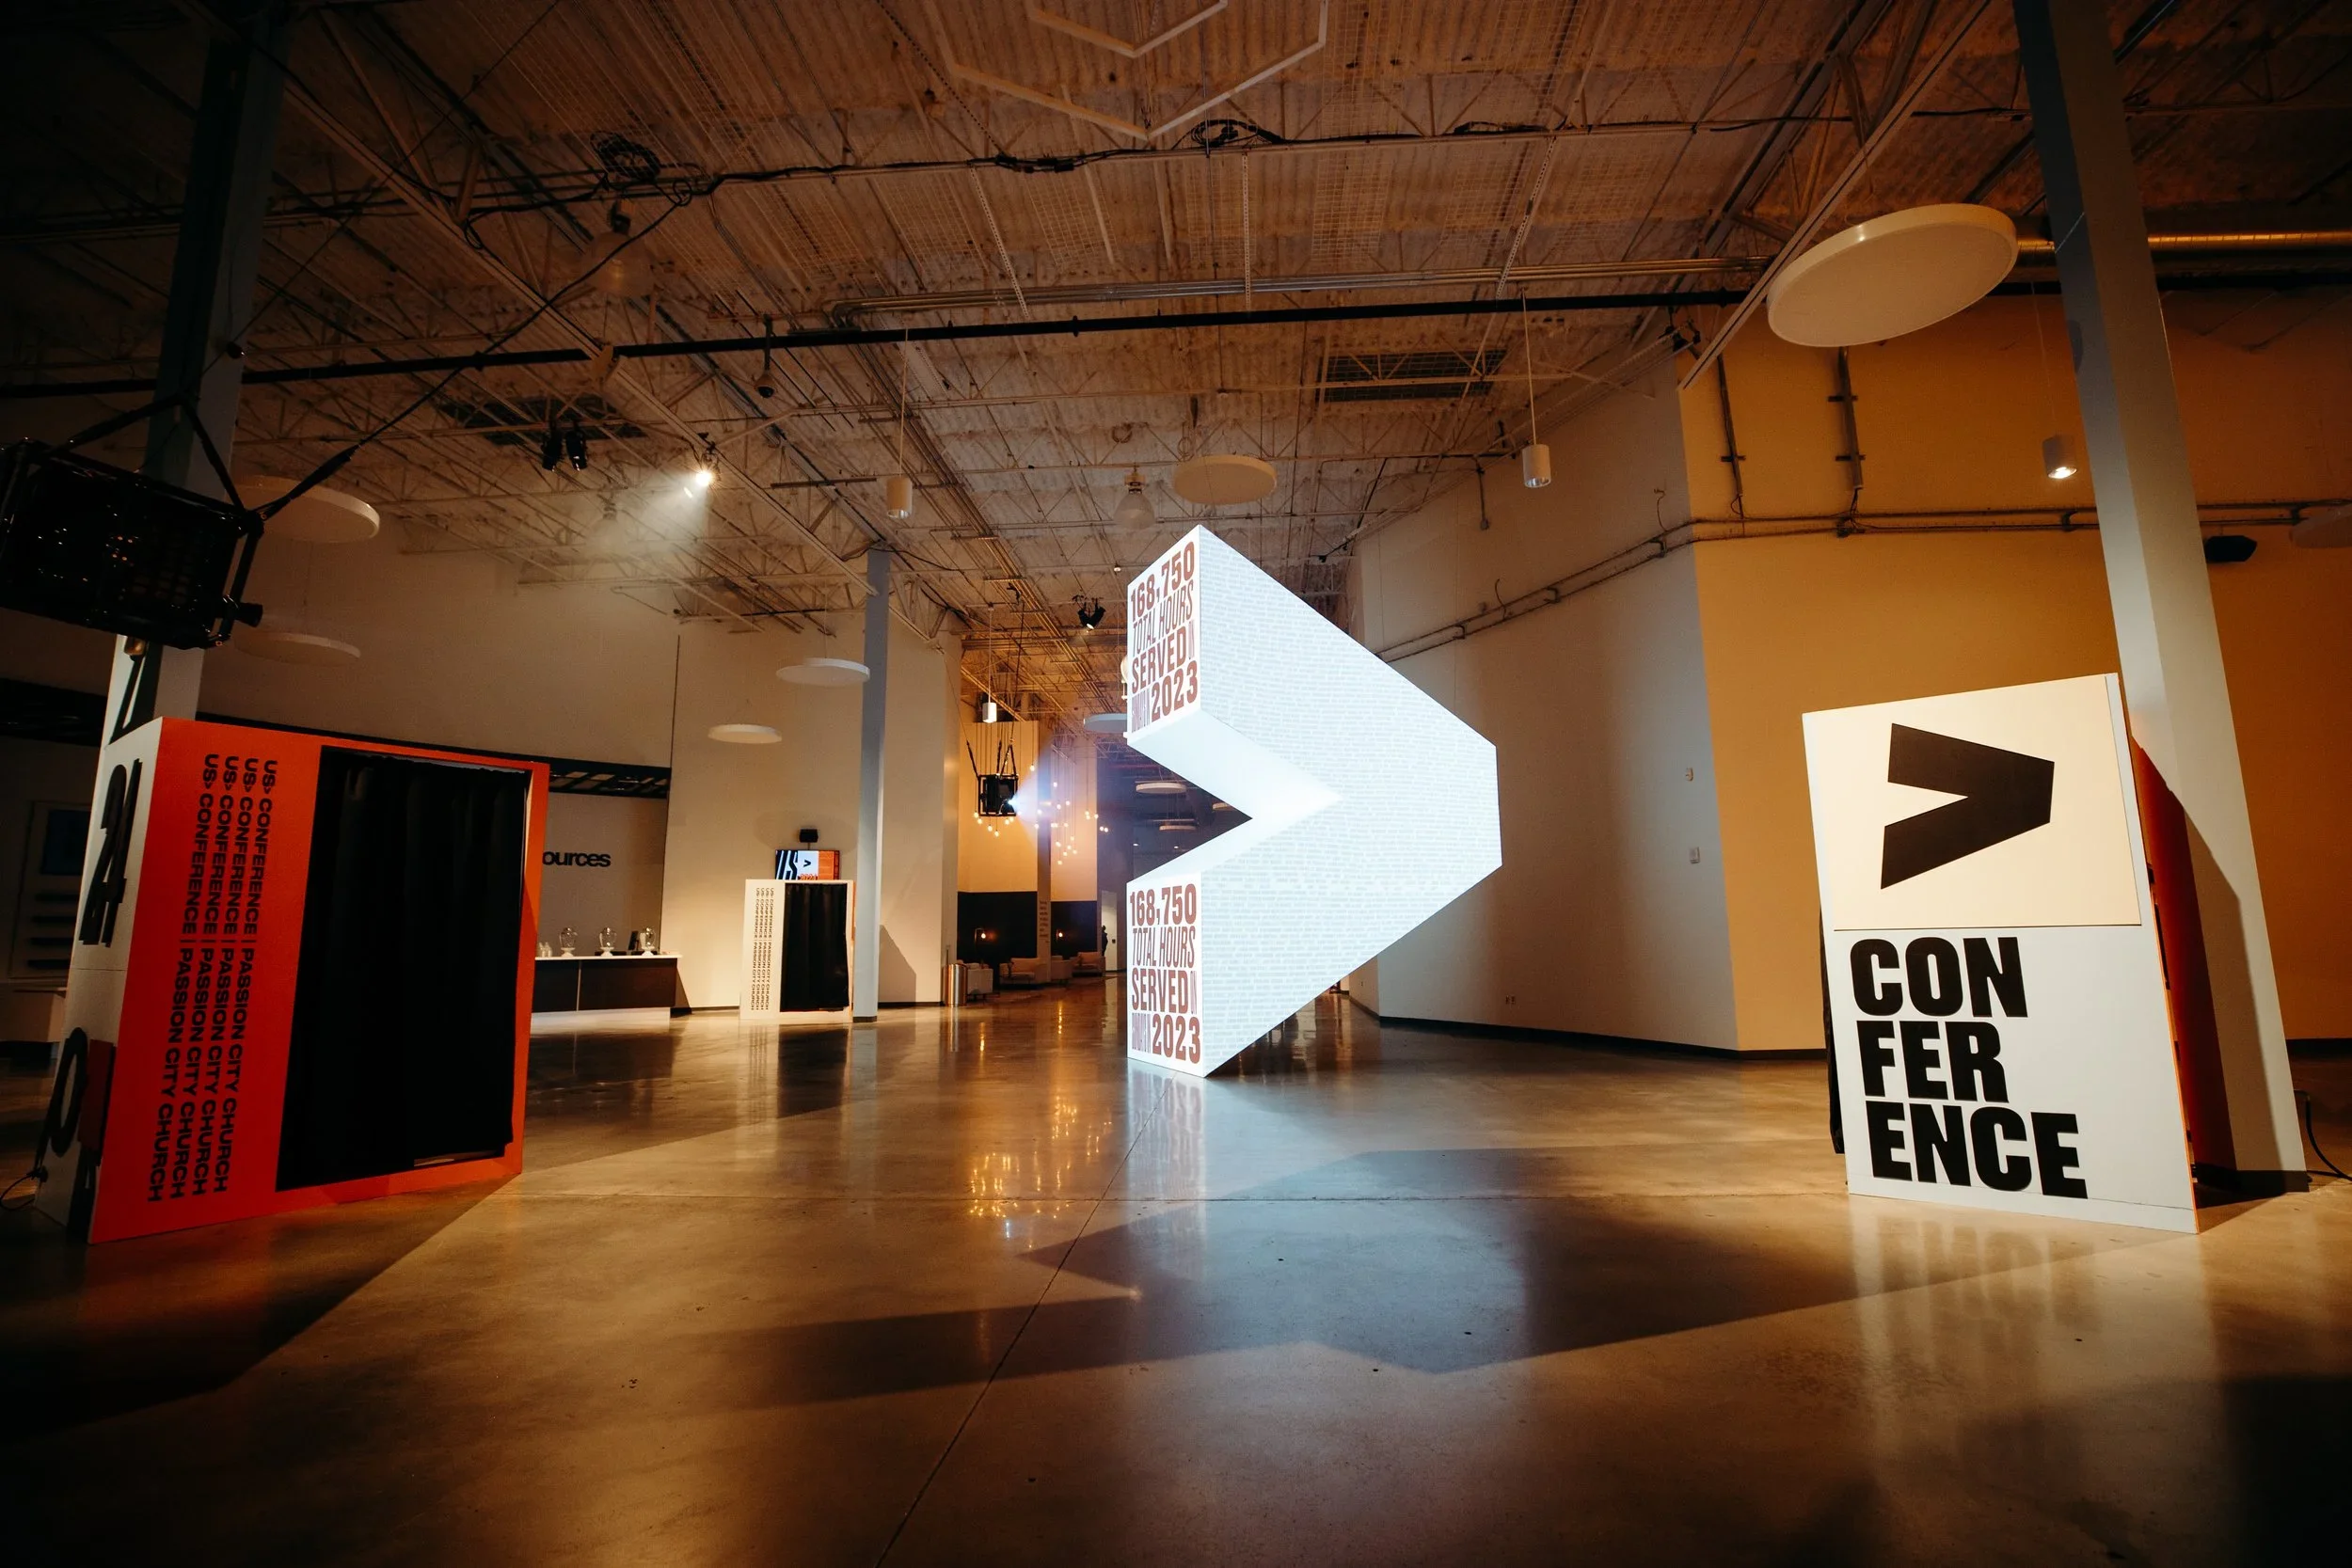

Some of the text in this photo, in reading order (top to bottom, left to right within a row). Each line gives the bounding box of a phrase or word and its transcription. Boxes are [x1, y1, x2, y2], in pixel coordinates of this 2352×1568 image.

[1131, 541, 1195, 622] 168,750
[1133, 579, 1194, 657] TOTAL HOURS
[1132, 626, 1186, 694] SERVED
[1152, 660, 1198, 722] 2023
[181, 792, 215, 933] CONFERENCE
[201, 794, 234, 933] CONFERENCE
[222, 796, 253, 933] CONFERENCE
[243, 797, 273, 934] CONFERENCE
[542, 851, 612, 867] ources
[1130, 883, 1197, 927] 168,750
[1133, 926, 1196, 968] TOTAL HOURS
[1850, 937, 2028, 1018] CON
[167, 947, 195, 1043] PASSION
[188, 947, 215, 1042] PASSION
[210, 947, 235, 1041] PASSION
[230, 947, 255, 1040] PASSION
[1132, 968, 1188, 1014] SERVED
[159, 1046, 183, 1098] CITY
[182, 1045, 204, 1097] CITY
[203, 1044, 224, 1095] CITY
[224, 1043, 245, 1093] CITY
[1152, 1013, 1201, 1064] 2023
[1856, 1021, 2010, 1103] FER
[146, 1101, 176, 1202] CHURCH
[168, 1100, 198, 1199] CHURCH
[191, 1098, 217, 1196] CHURCH
[212, 1096, 238, 1194] CHURCH
[1865, 1101, 2089, 1199] ENCE
